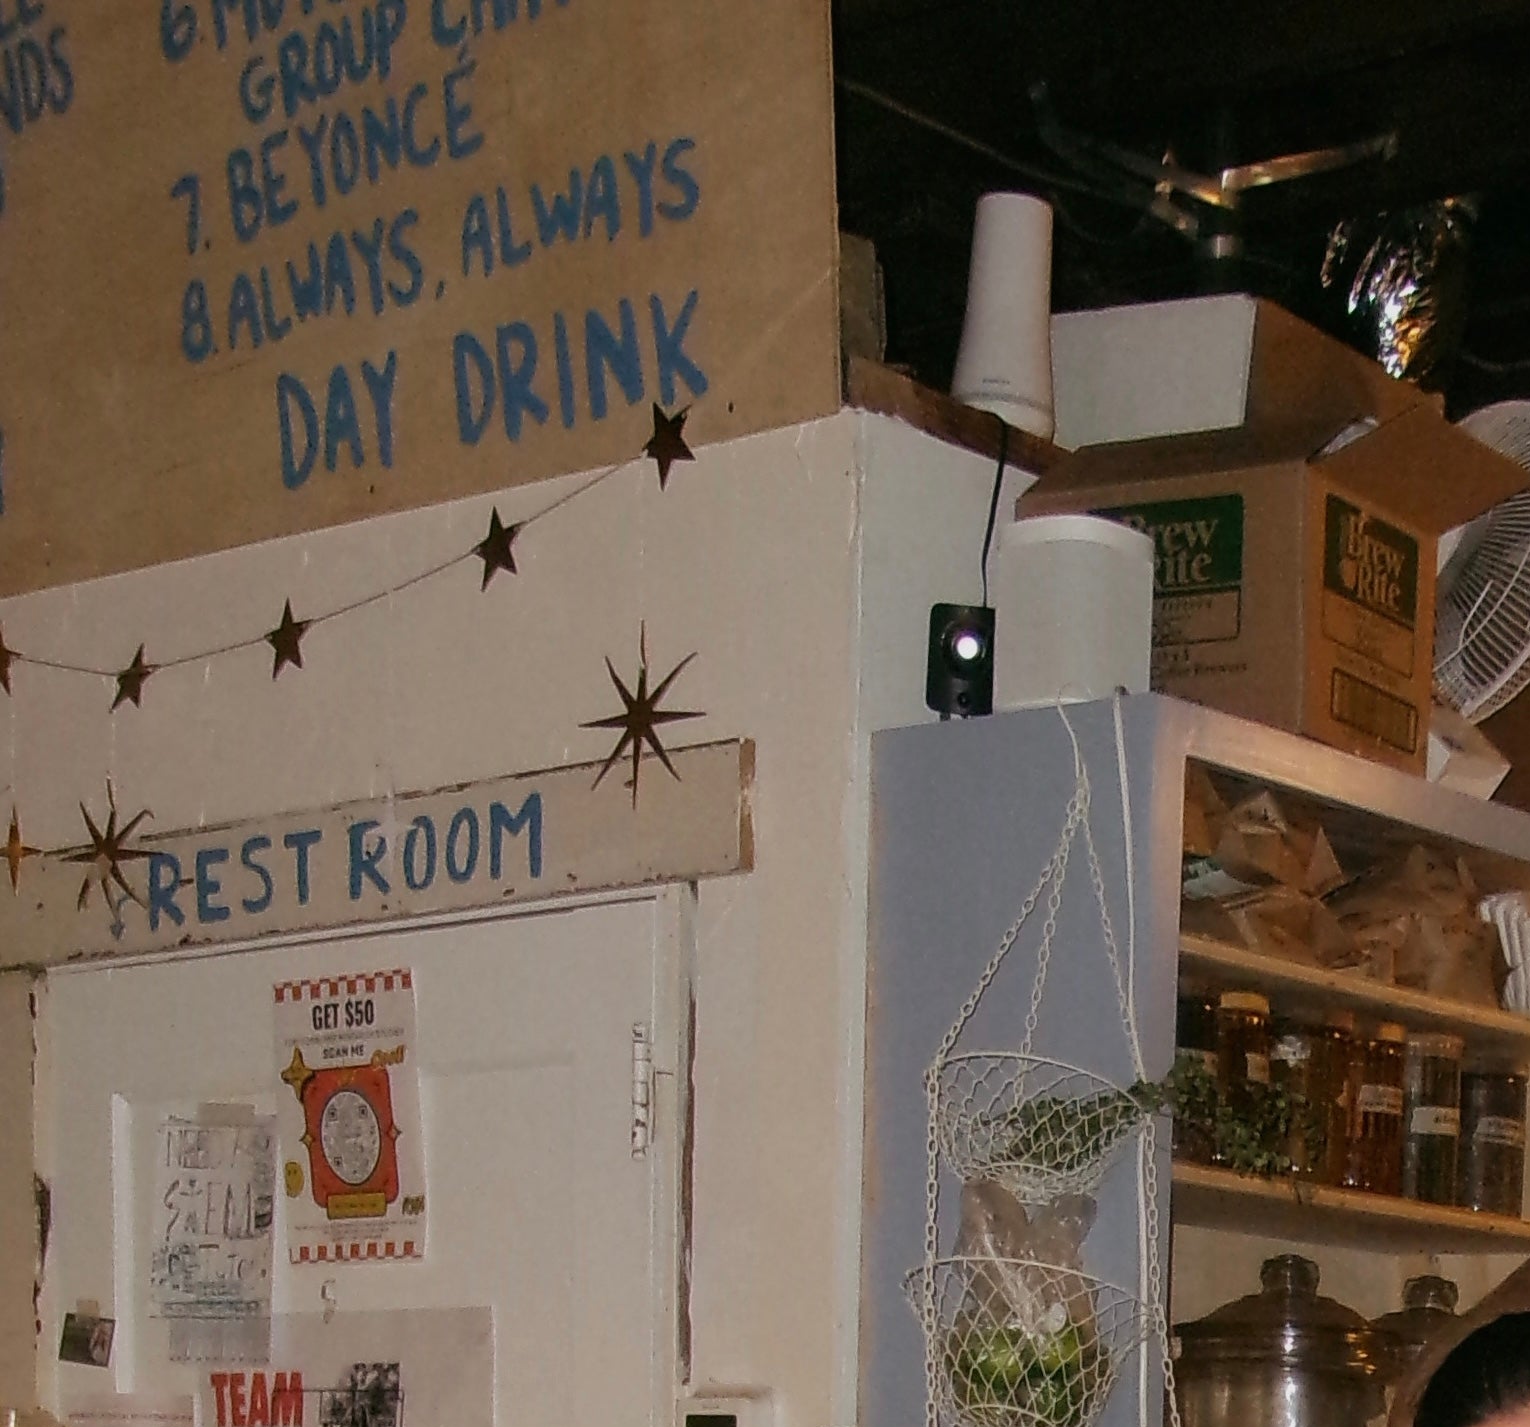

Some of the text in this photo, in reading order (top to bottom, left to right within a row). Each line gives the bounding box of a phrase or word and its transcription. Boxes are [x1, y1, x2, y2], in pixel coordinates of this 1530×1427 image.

[239, 0, 406, 122] GROUP
[227, 46, 485, 243] BEYONCÉ
[462, 137, 701, 278] ALWAYS
[275, 289, 710, 492] DAY DRINK
[1153, 549, 1212, 590] ite
[147, 791, 545, 934] REST ROOM
[312, 999, 374, 1030] GET $50
[322, 1047, 348, 1059] SCAN
[351, 1045, 365, 1057] ME
